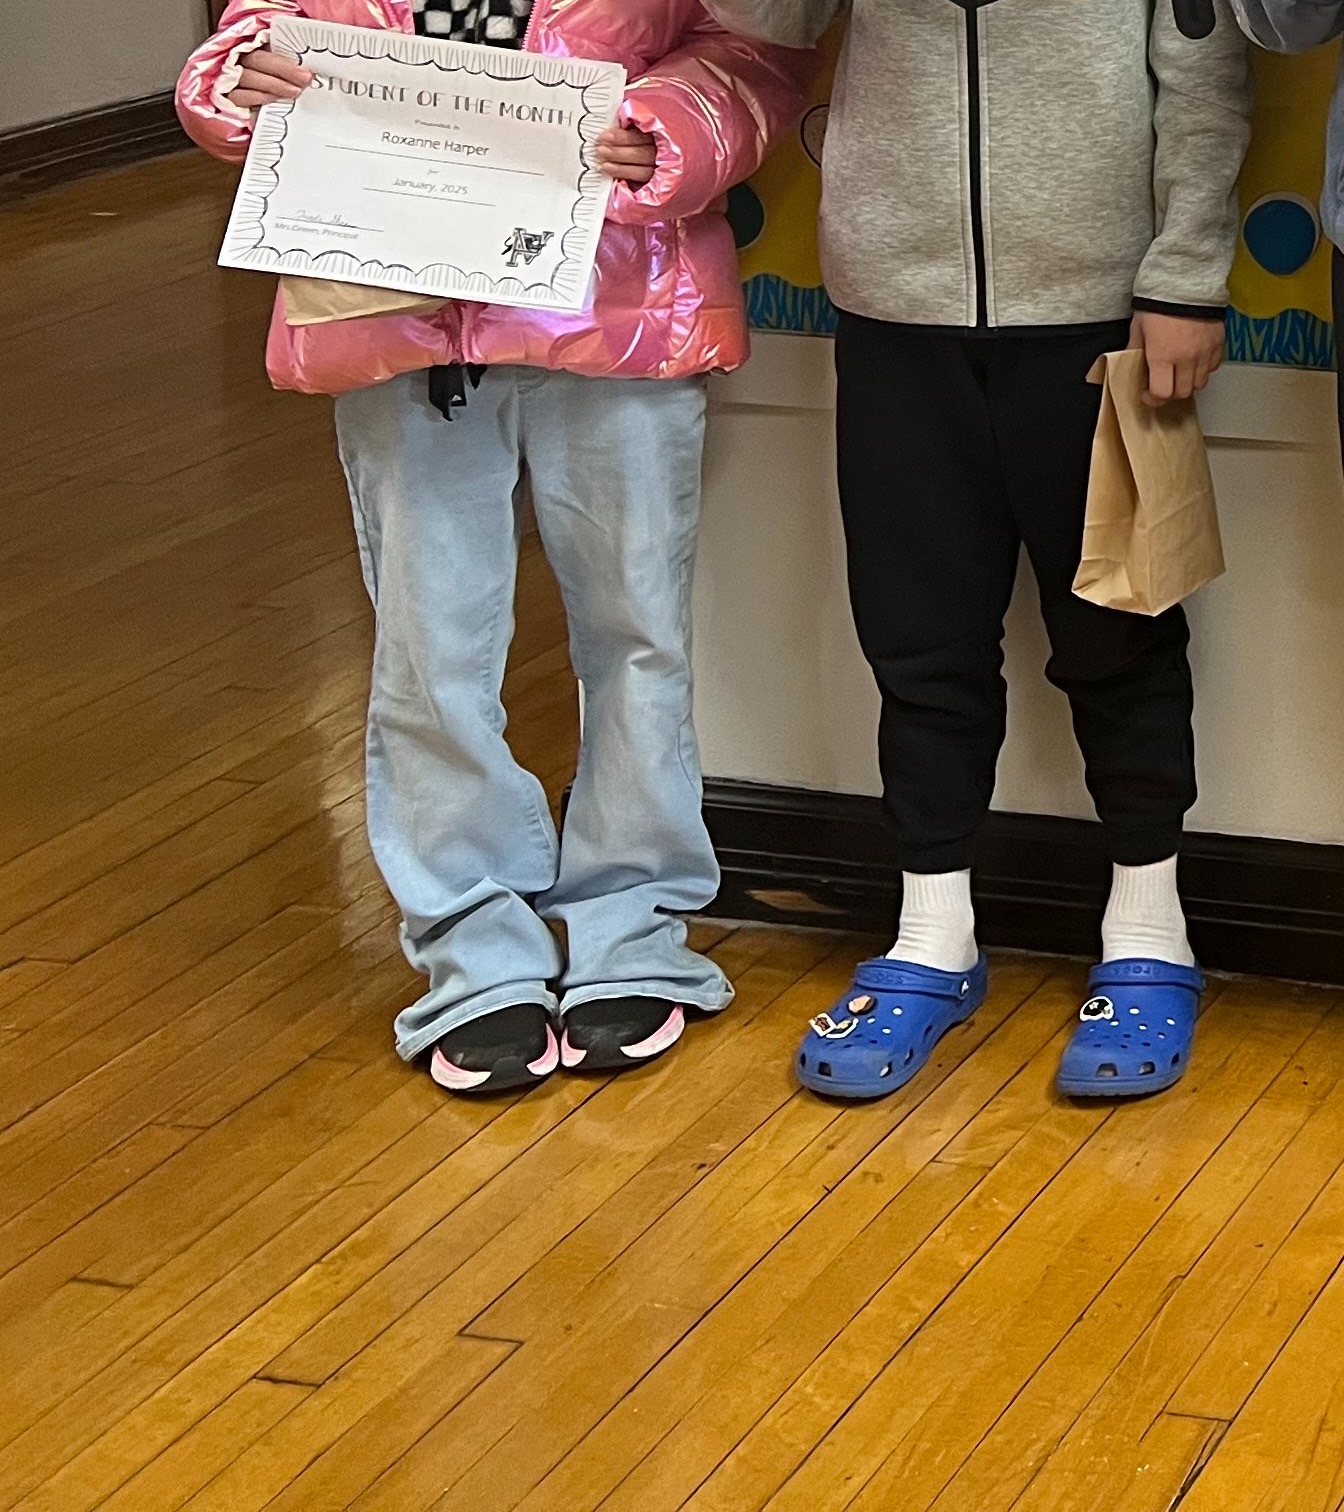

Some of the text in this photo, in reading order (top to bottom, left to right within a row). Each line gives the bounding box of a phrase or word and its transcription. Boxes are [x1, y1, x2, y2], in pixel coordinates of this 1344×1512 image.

[311, 72, 573, 126] STUDENT OF THE MONTH
[381, 131, 490, 156] Roxanne Harper
[440, 182, 469, 195] 2025
